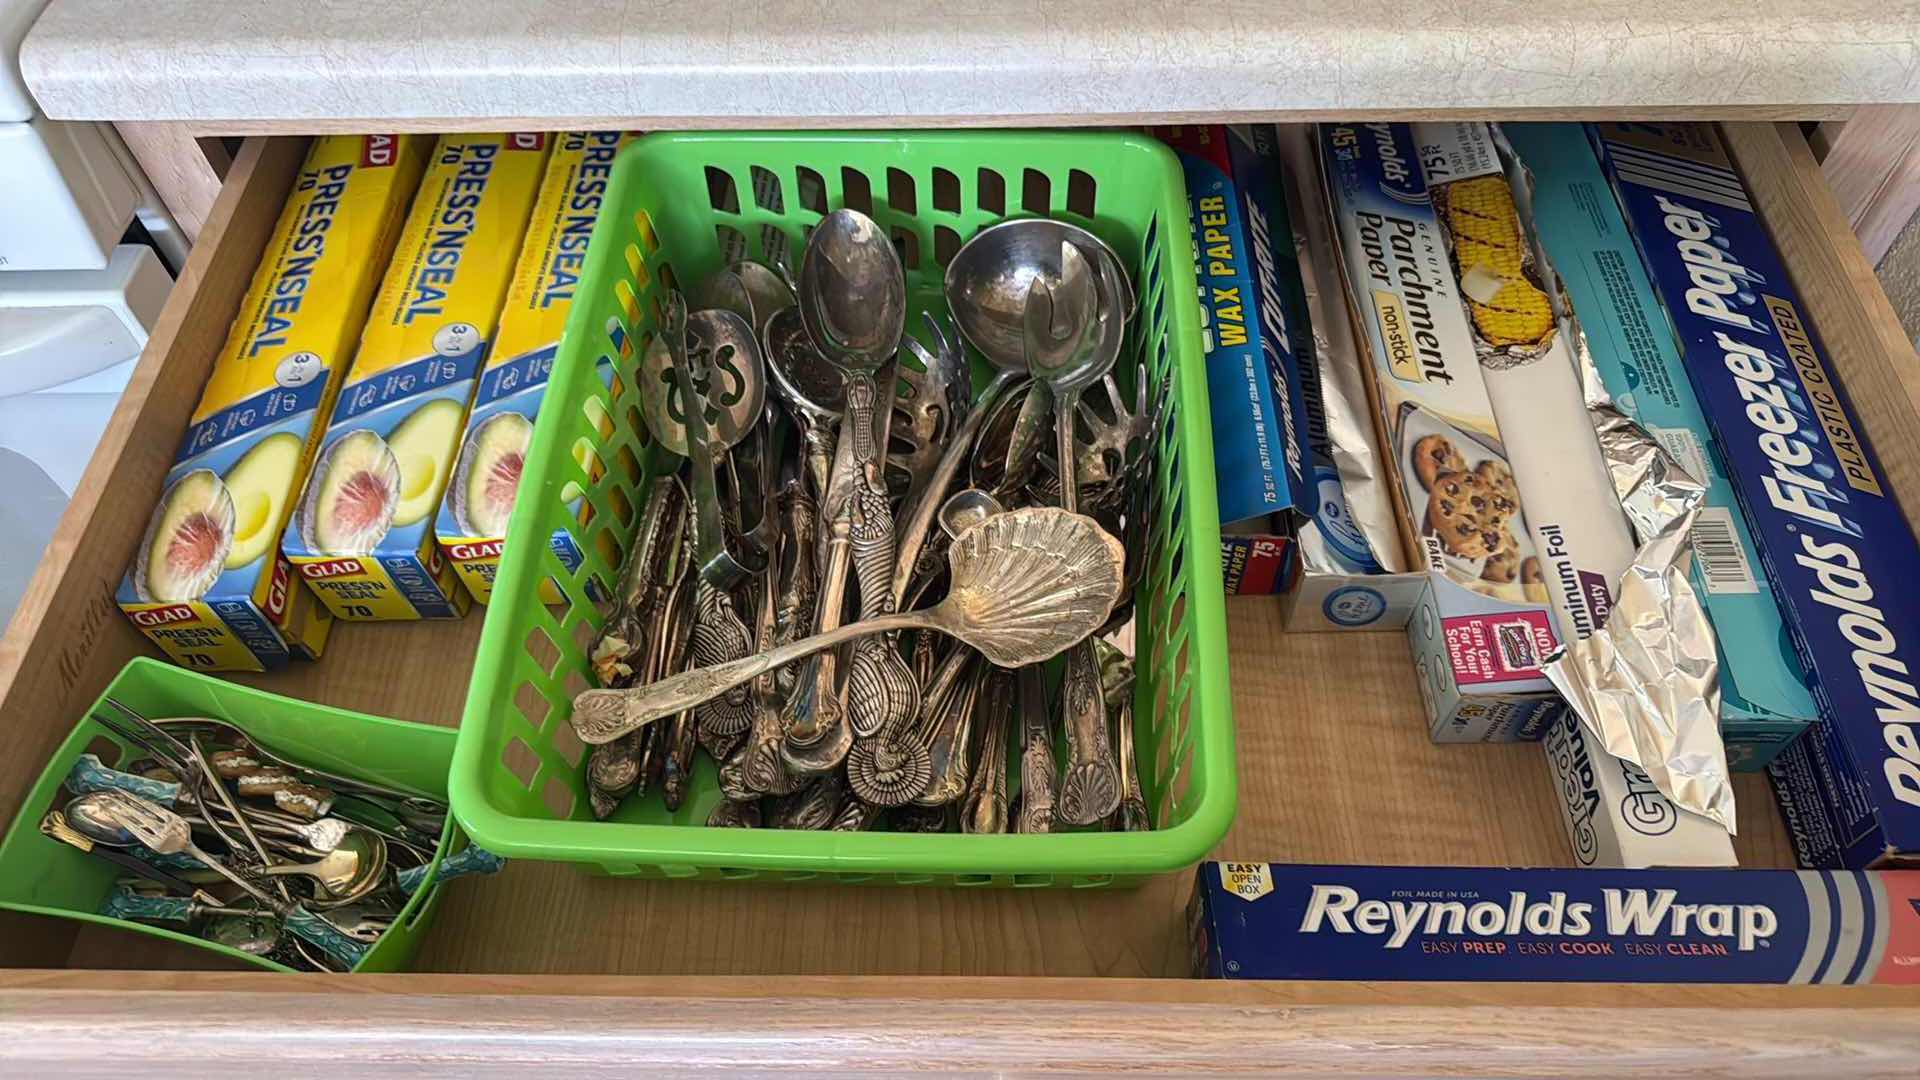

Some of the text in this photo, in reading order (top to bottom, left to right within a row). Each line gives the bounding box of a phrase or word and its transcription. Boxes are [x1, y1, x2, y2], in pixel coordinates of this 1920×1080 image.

[369, 134, 392, 165] AD
[441, 144, 466, 166] 70
[565, 131, 585, 152] 70
[1366, 122, 1407, 188] ynolds
[1424, 157, 1449, 181] 75
[1200, 194, 1238, 277] PAPER
[1355, 210, 1393, 287] Paper
[1418, 223, 1447, 298] GENUINE
[1653, 194, 1757, 331] Paper
[1212, 286, 1249, 348] WAX
[1384, 216, 1453, 386] Parchment
[1381, 304, 1409, 366] non-stick
[1773, 304, 1872, 483] PLASTIC COATED
[1272, 369, 1304, 482] Reynolds
[1713, 331, 1850, 533] Freezer
[303, 560, 361, 579] GLAD
[1232, 545, 1249, 572] PAPER
[1252, 541, 1276, 558] 75
[1425, 538, 1445, 571] BAKE
[269, 560, 291, 615] GLA
[336, 589, 383, 601] SEAL
[1540, 523, 1593, 641] uminum Foil
[1591, 584, 1611, 617] Duty
[135, 605, 192, 626] GLAD
[341, 605, 373, 618] 70
[181, 654, 217, 667] 70
[1445, 626, 1467, 675] School!
[1457, 624, 1480, 676] For Your
[1469, 618, 1495, 680] Earn Cash
[1565, 707, 1600, 819] Value
[1544, 719, 1598, 866] Great
[1777, 781, 1812, 867] Reynolds
[1227, 863, 1262, 873] EASY
[1231, 873, 1262, 885] OPEN
[1236, 883, 1261, 895] BOX
[1391, 890, 1414, 898] FOIL
[1299, 884, 1778, 951] Reynolds Wrap
[1422, 941, 1507, 954] EASY PREP
[1518, 942, 1615, 955] EASY COOK
[1624, 943, 1728, 957] EASY CLEAN
